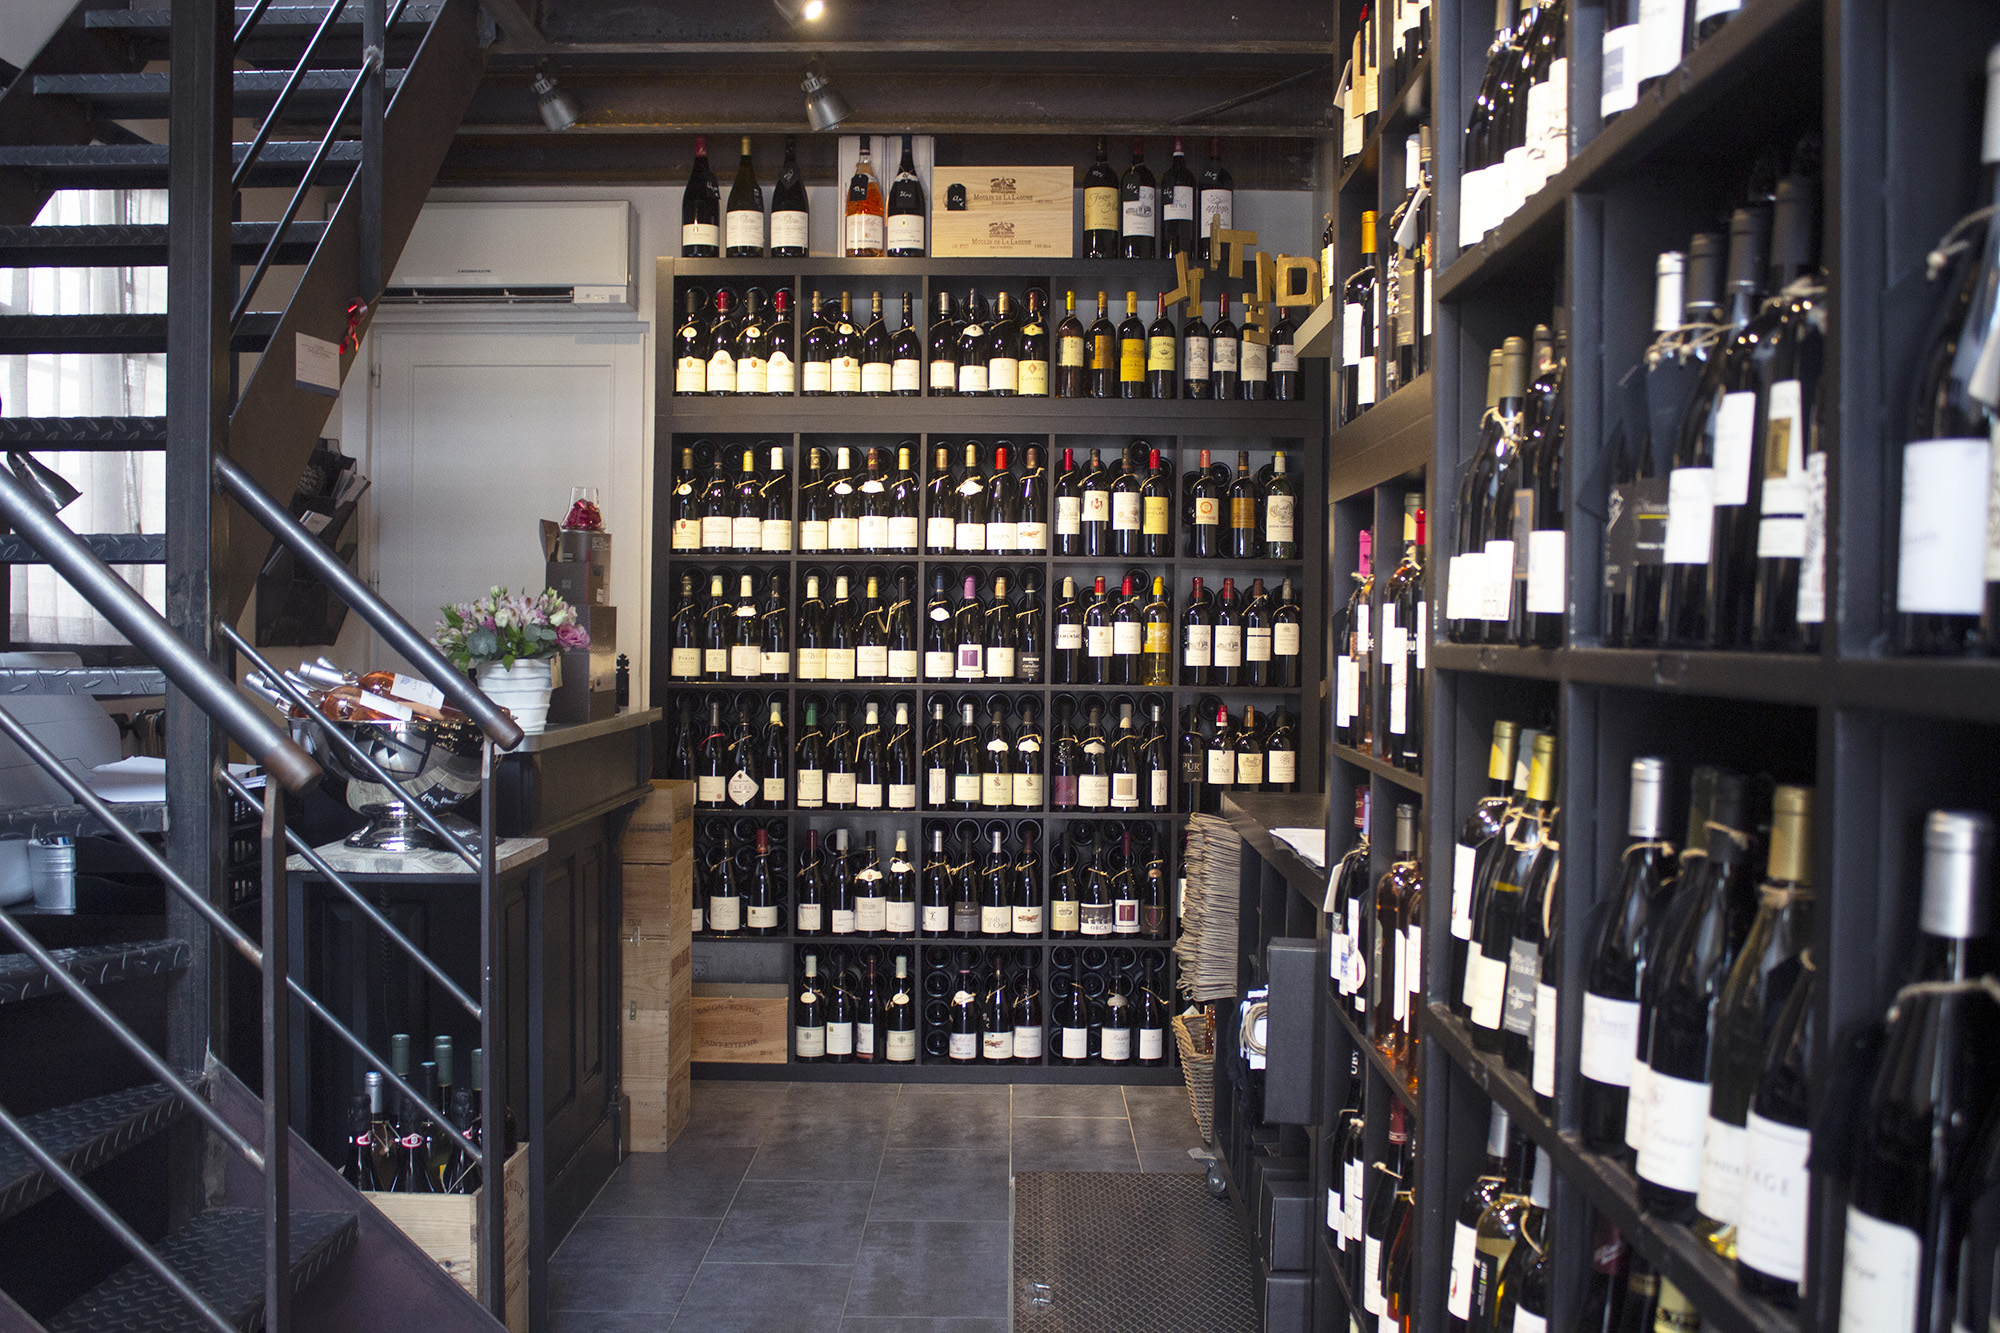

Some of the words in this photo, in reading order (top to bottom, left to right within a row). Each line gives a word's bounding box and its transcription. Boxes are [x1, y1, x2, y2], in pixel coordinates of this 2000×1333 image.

[973, 193, 996, 201] MOULIN
[1003, 193, 1010, 201] LA
[972, 238, 994, 246] MOULIN
[1001, 238, 1009, 246] LA
